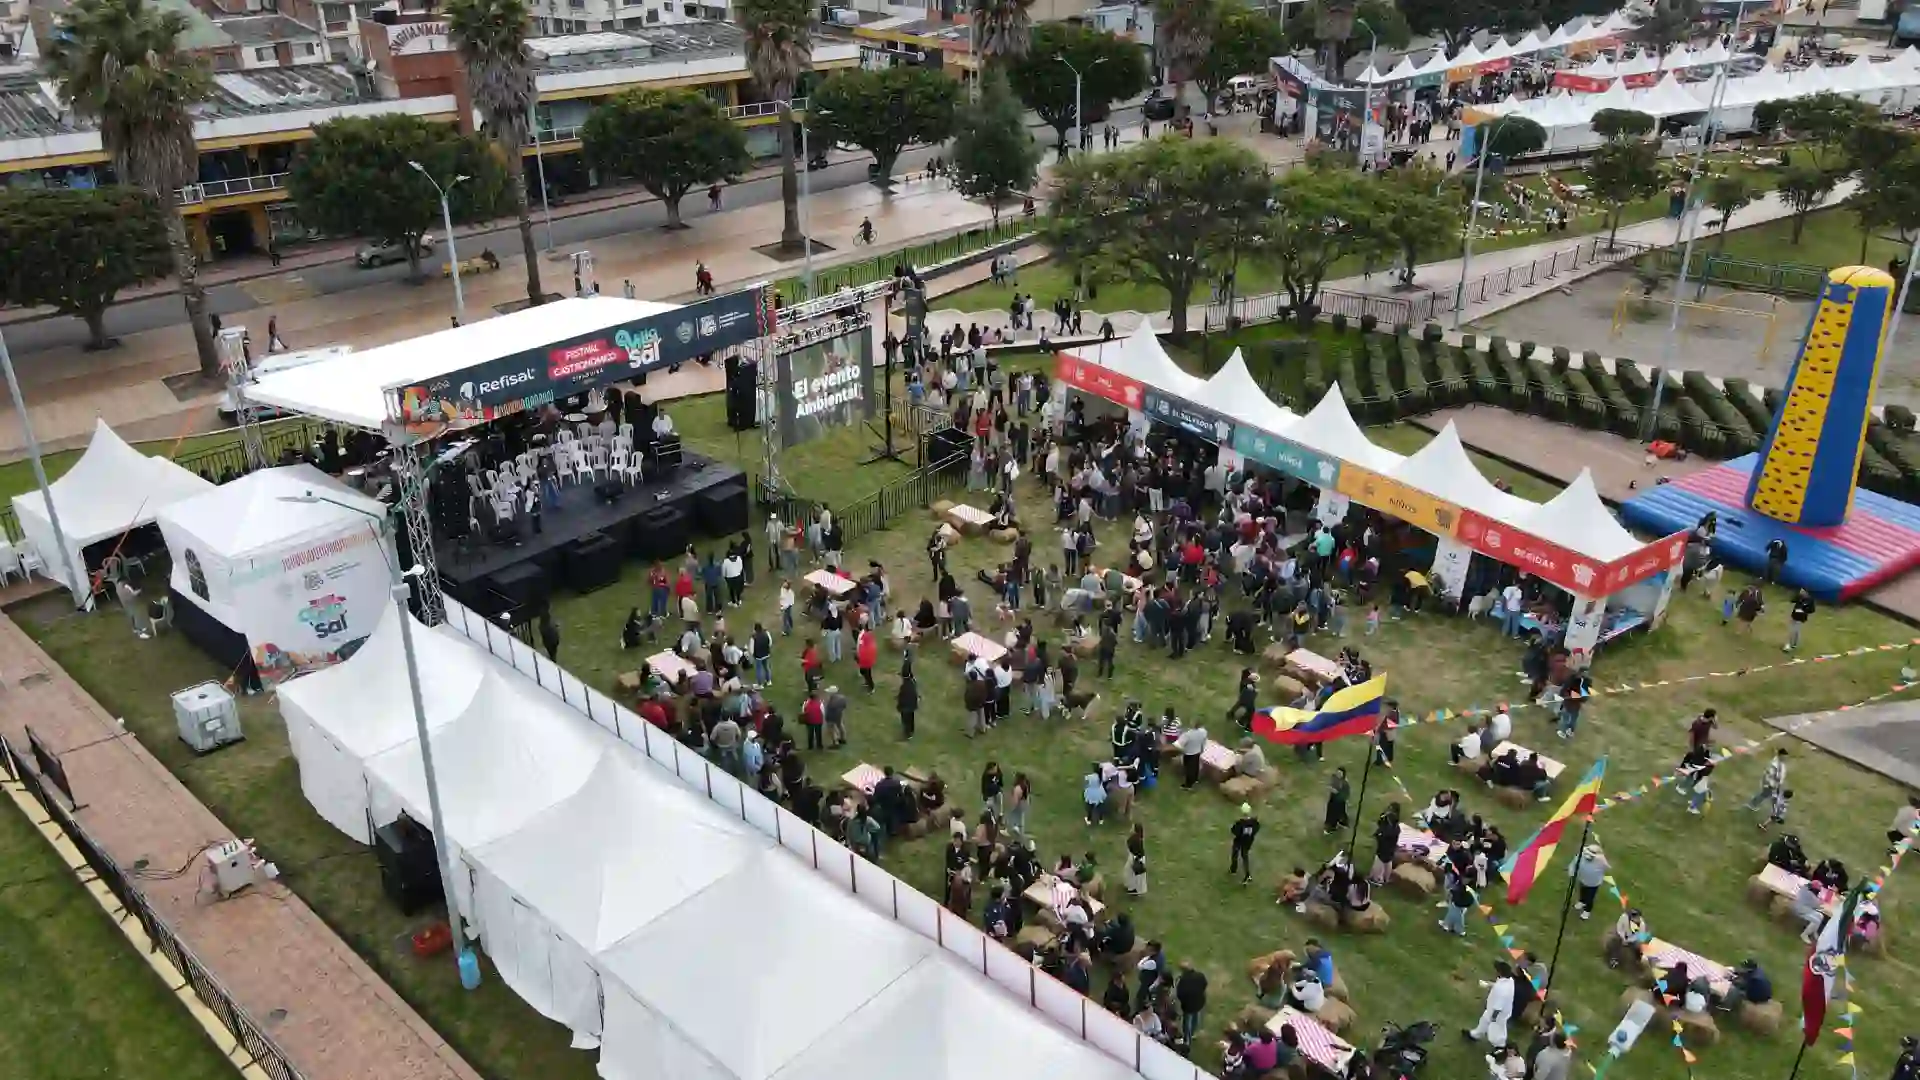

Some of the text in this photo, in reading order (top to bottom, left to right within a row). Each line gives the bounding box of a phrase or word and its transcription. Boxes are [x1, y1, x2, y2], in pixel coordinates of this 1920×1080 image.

[479, 367, 534, 394] Refisal
[793, 365, 860, 398] El evento
